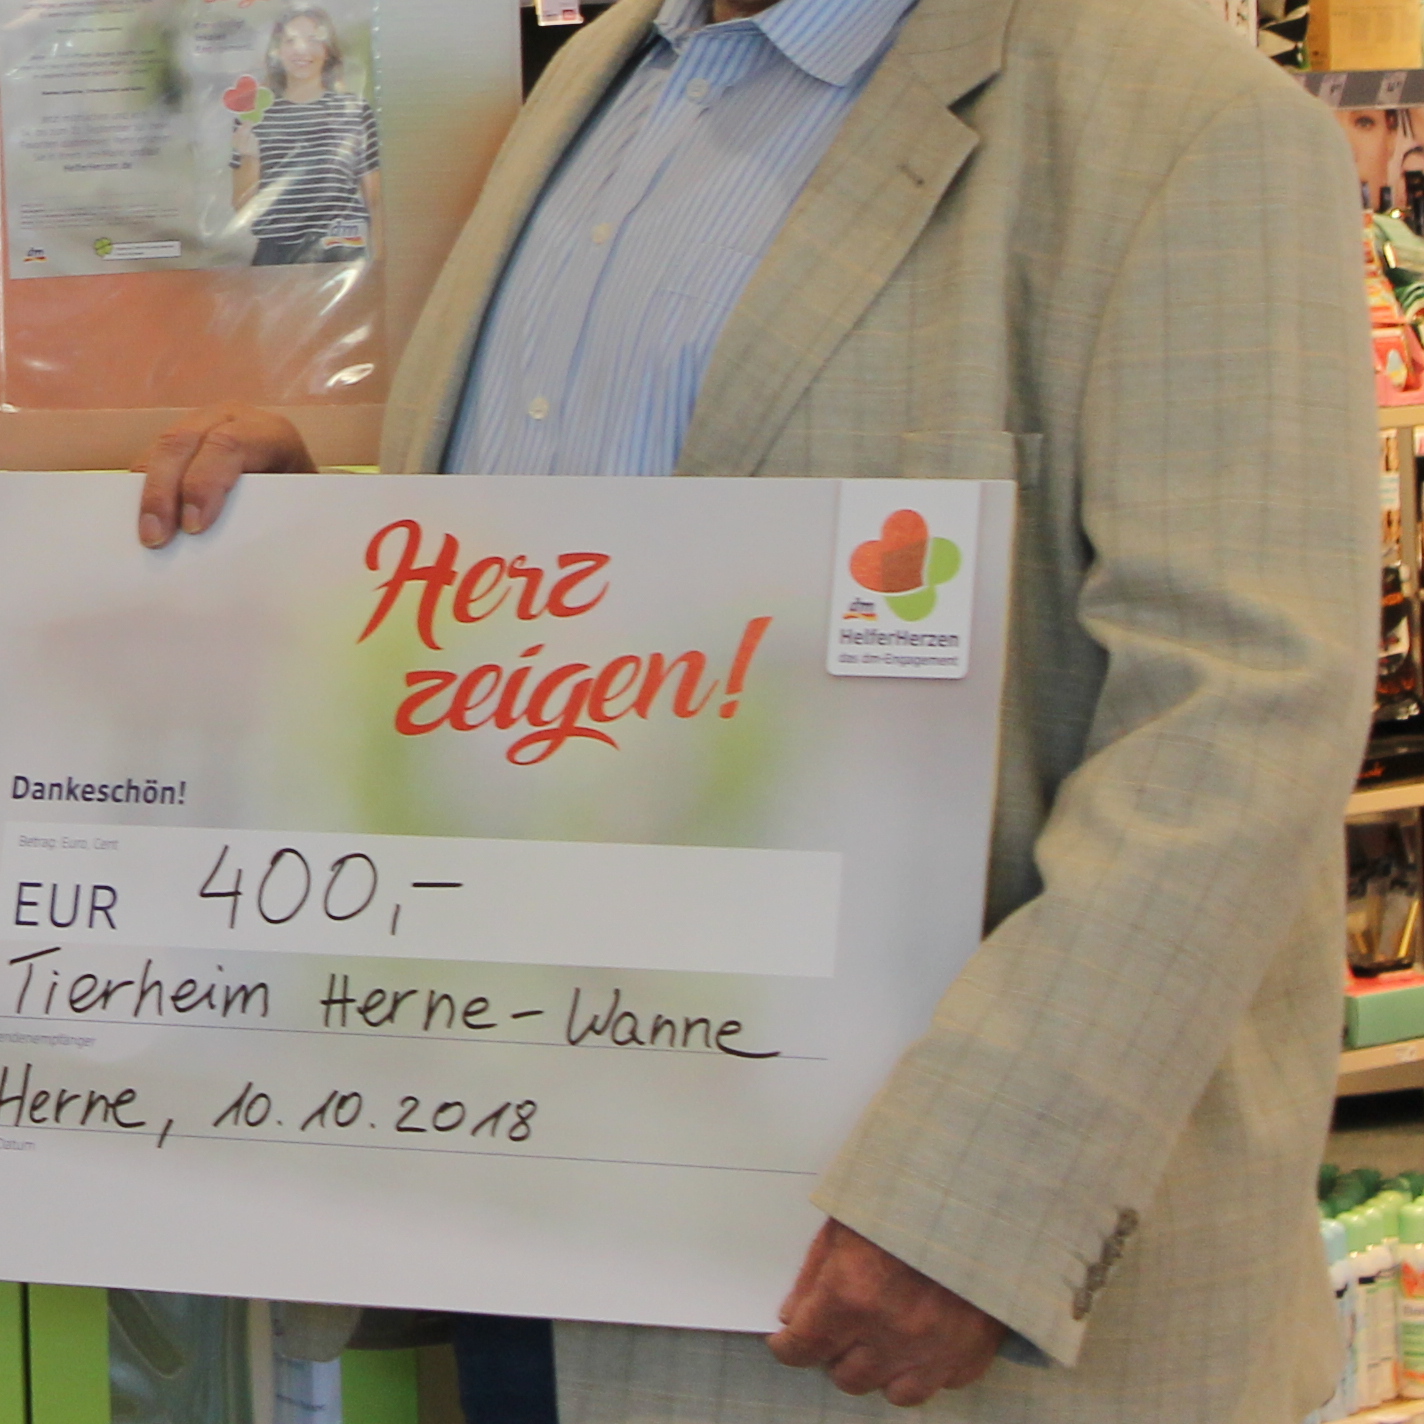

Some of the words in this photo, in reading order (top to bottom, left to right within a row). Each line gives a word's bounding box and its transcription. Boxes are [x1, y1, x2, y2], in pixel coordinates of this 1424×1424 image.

[356, 519, 611, 651] Herz
[839, 628, 959, 647] HelferHerzen
[394, 615, 773, 766] zeigen!
[11, 775, 187, 806] Dankeschön!
[14, 882, 118, 931] EUR
[9, 946, 271, 1019] Tierheim
